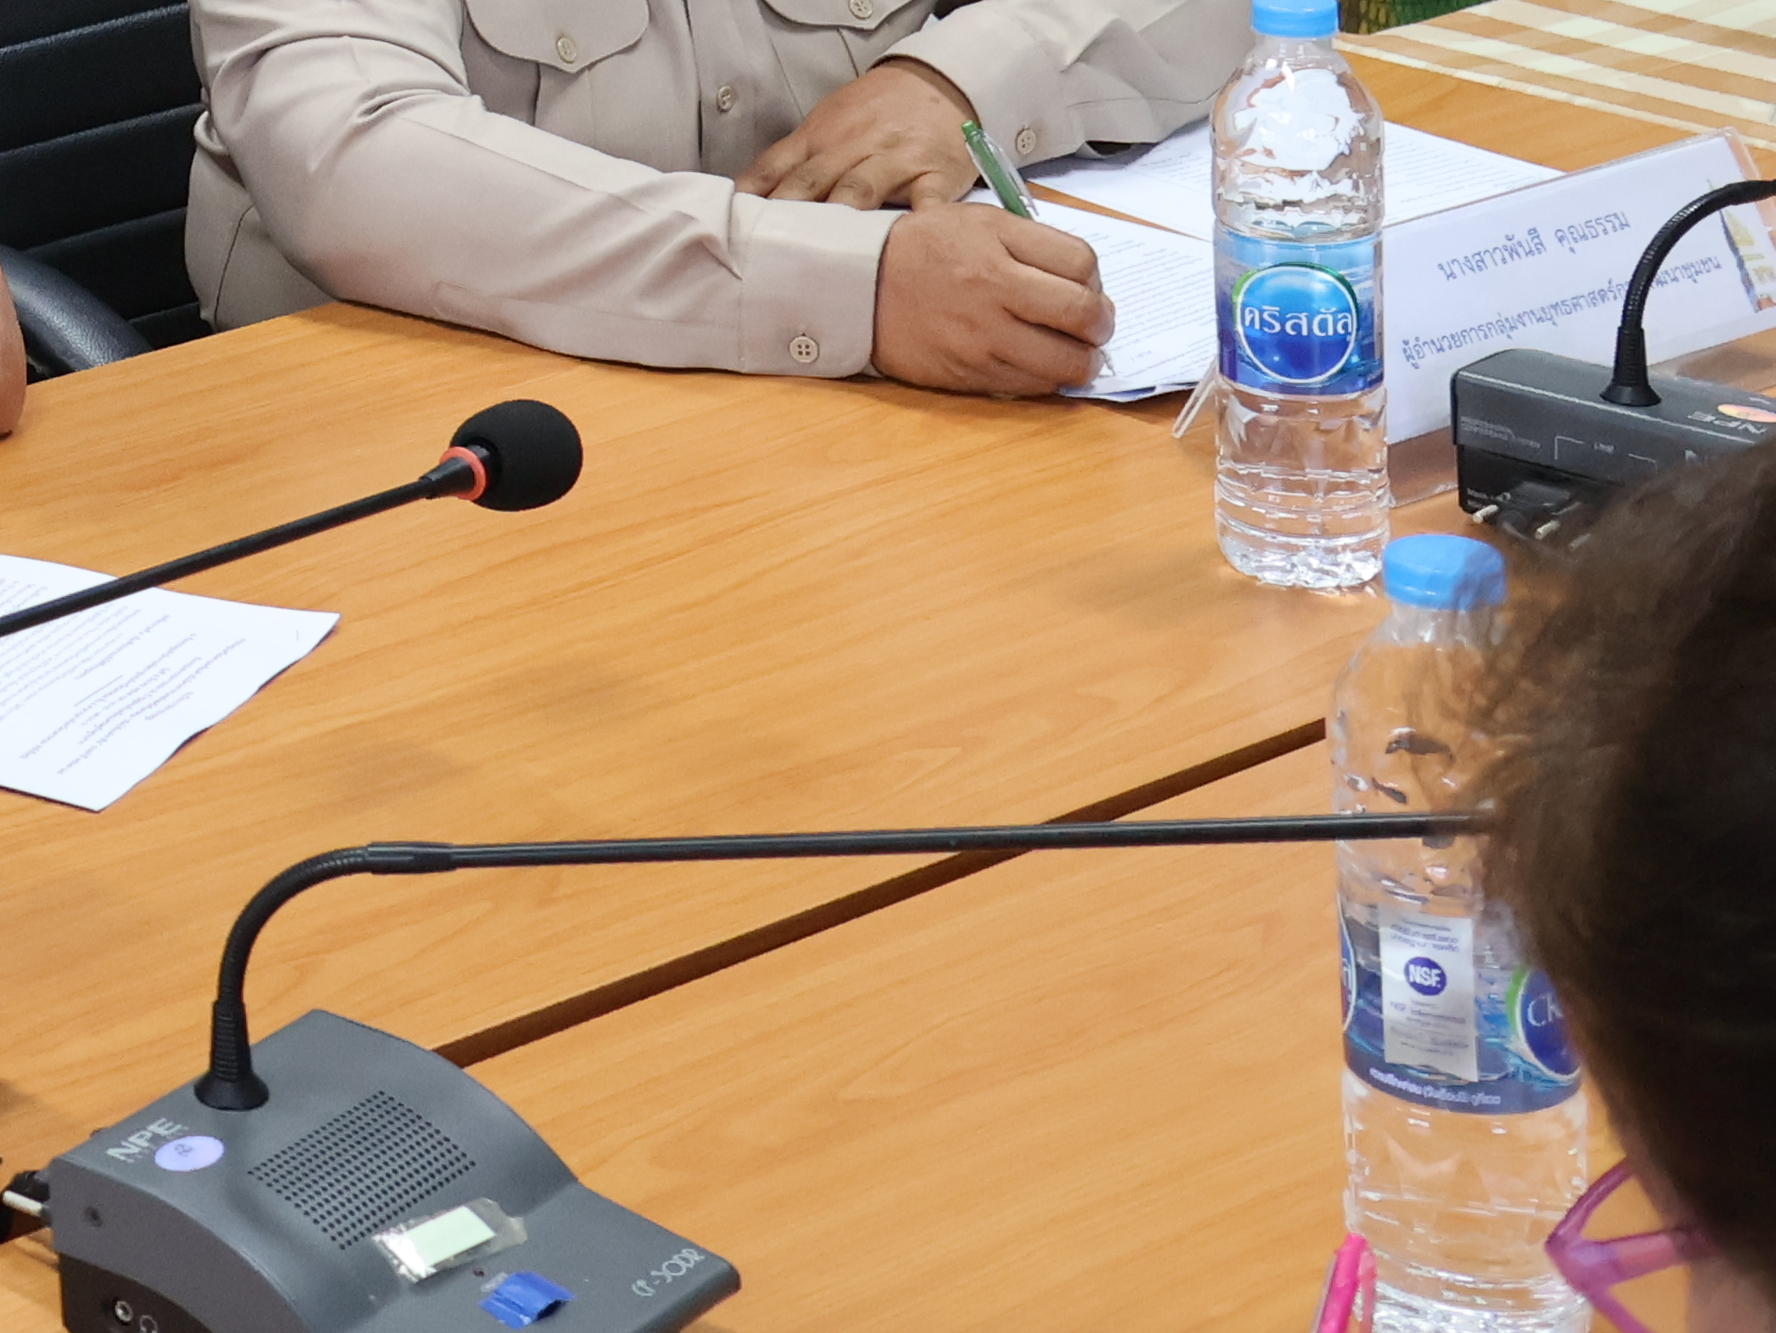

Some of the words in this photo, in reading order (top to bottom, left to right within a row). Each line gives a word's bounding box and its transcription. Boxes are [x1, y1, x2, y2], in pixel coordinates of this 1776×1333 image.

[1436, 225, 1547, 284] นางสาวพันสี
[1554, 206, 1631, 258] คุณธรรม
[1243, 302, 1353, 338] คริสตัล
[107, 1117, 183, 1161] NPE
